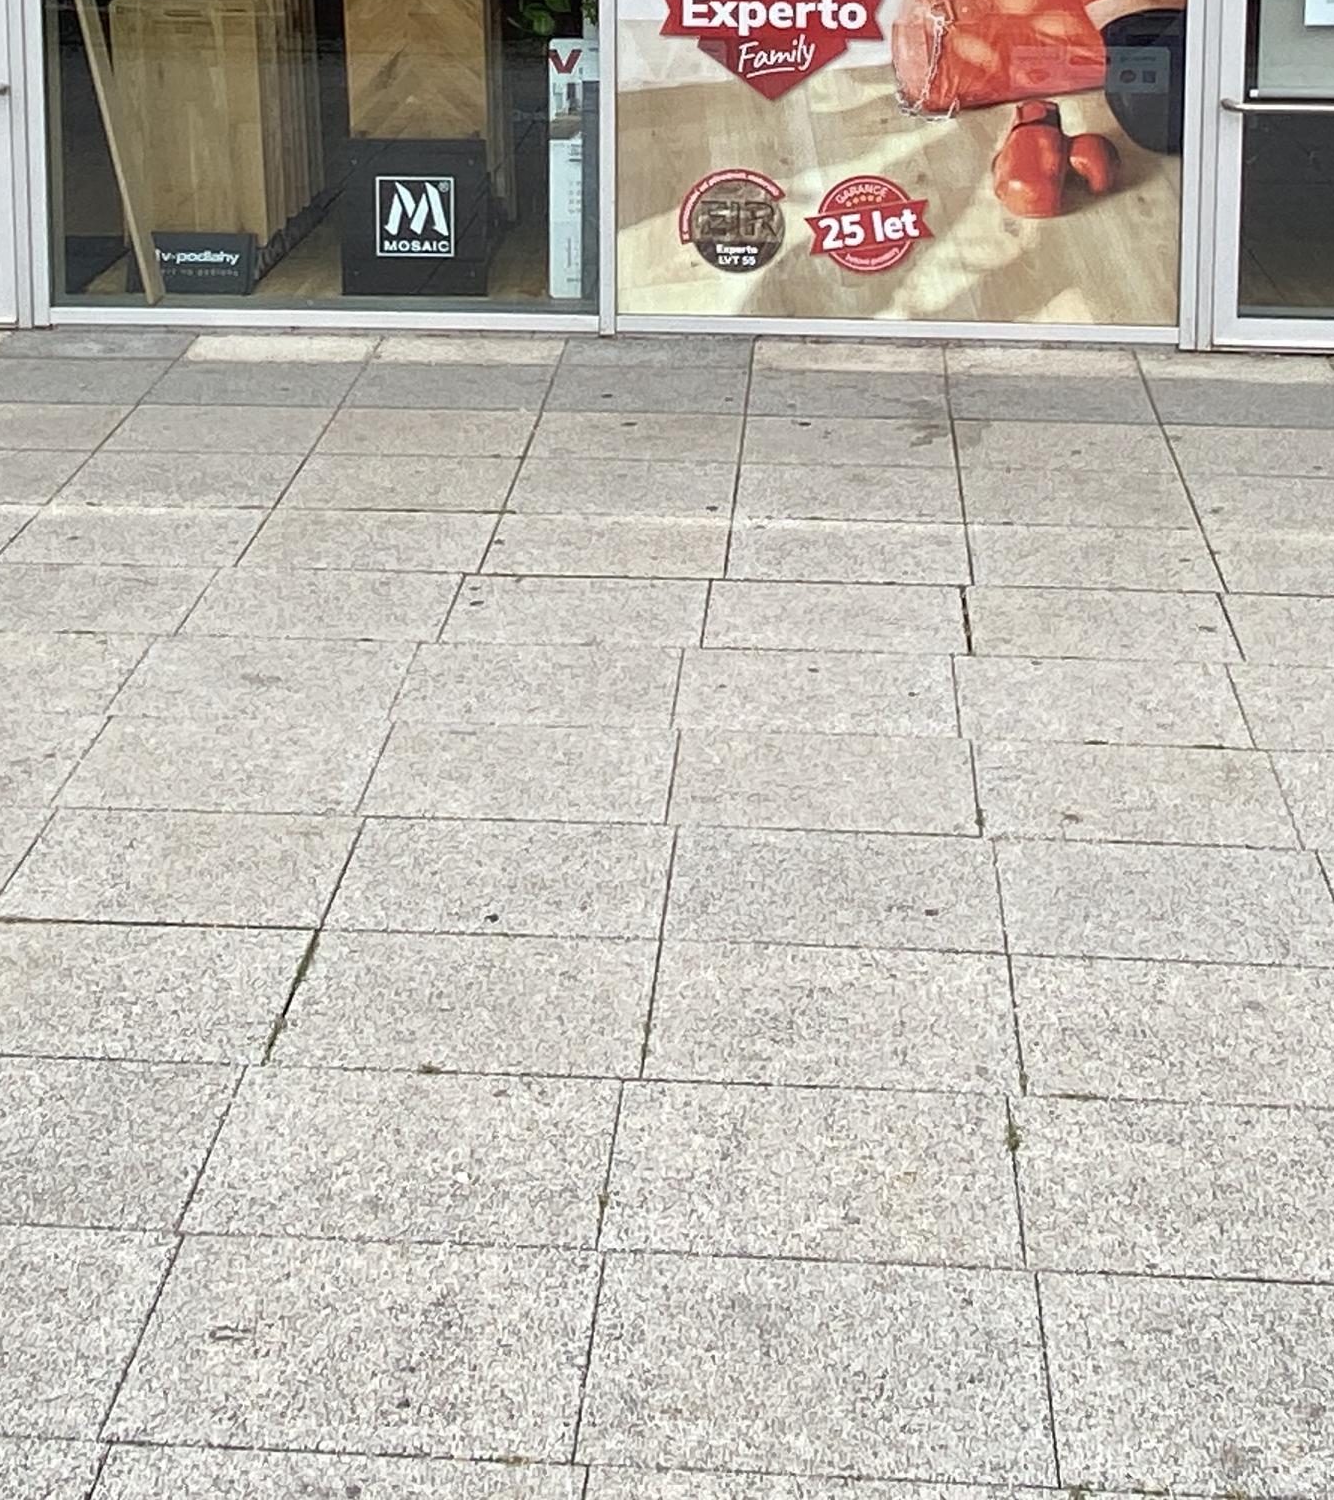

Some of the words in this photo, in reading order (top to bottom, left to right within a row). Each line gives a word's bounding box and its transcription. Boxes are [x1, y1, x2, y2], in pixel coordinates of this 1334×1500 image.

[738, 33, 815, 74] Family
[835, 184, 889, 204] GARANCE
[818, 213, 865, 250] 25
[872, 208, 920, 242] let
[383, 240, 450, 253] MOSAIC
[715, 244, 759, 256] Experto
[718, 256, 739, 266] LVT
